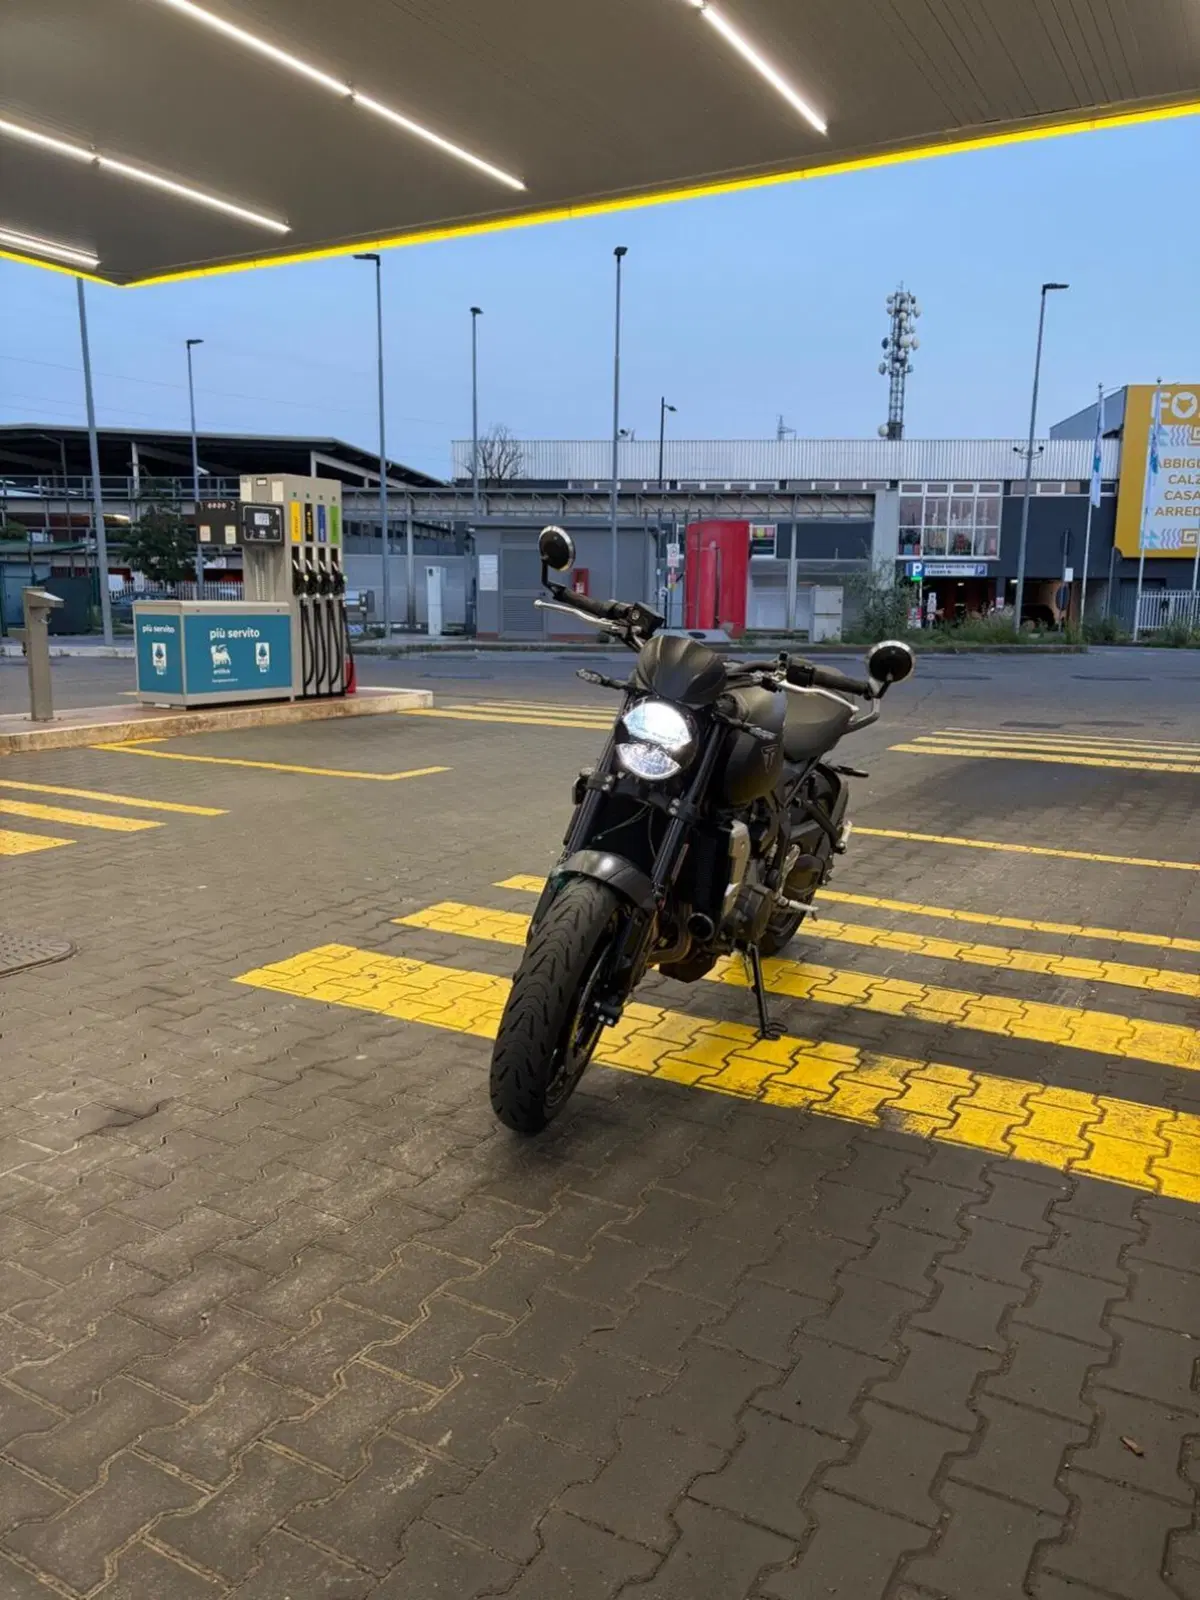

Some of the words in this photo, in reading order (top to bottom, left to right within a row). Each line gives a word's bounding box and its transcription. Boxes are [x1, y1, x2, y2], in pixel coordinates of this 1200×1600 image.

[1151, 391, 1200, 419] FO
[1159, 458, 1200, 469] BBIGL
[912, 562, 923, 576] P
[142, 624, 152, 634] più
[153, 624, 175, 634] servito
[209, 627, 226, 641] più
[227, 627, 260, 639] servito
